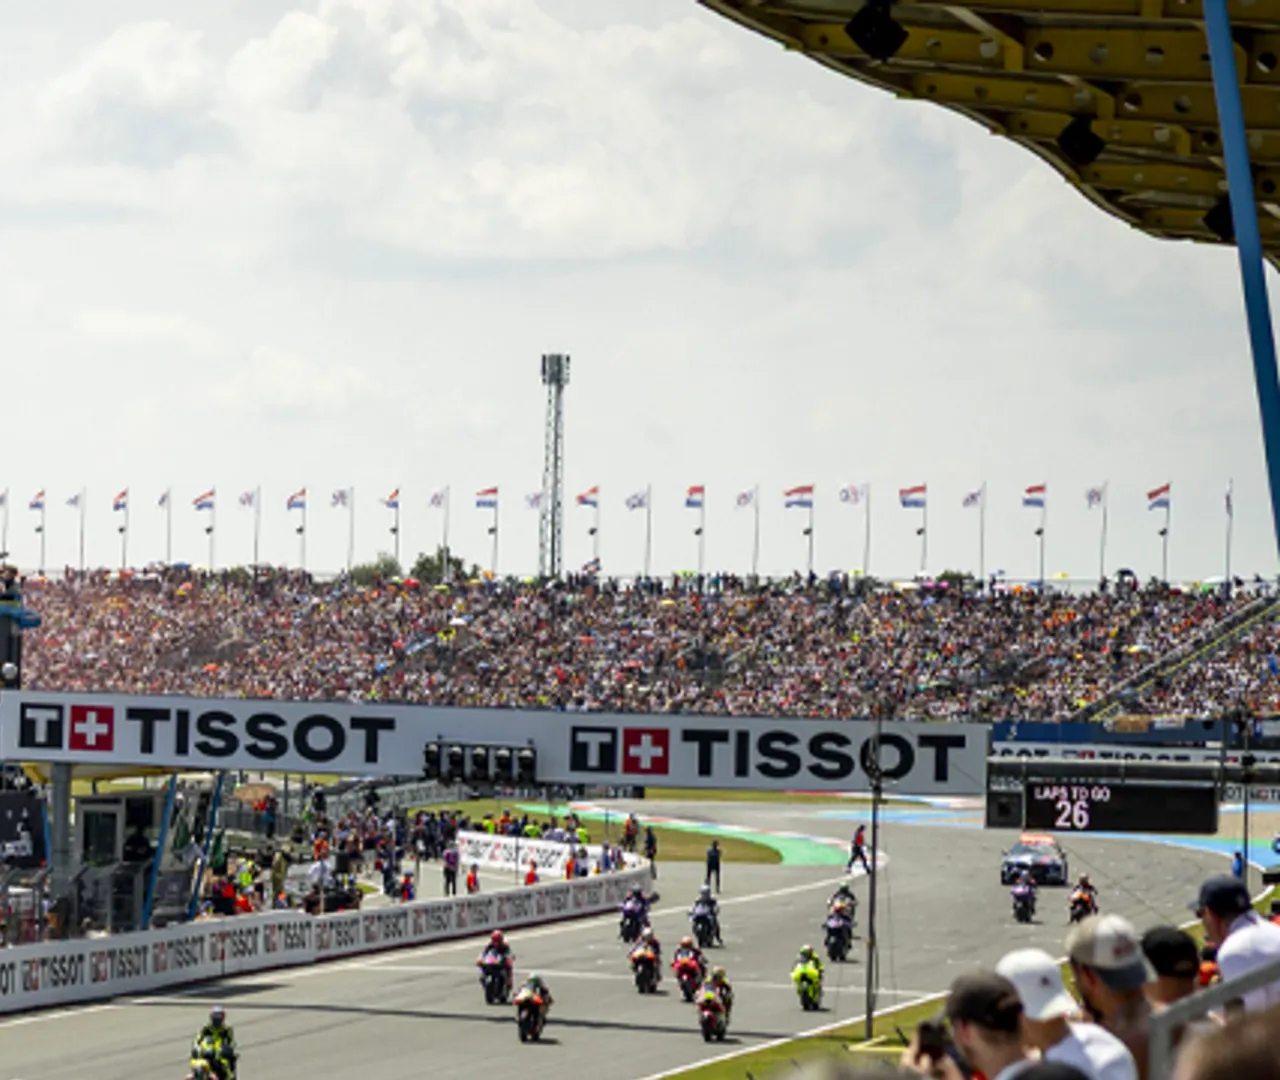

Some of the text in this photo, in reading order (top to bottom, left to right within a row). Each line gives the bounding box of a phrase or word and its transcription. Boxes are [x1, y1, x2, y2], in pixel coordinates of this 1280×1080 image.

[125, 706, 397, 763] TISSOT
[680, 728, 967, 783] TISSOT
[1034, 786, 1110, 802] LAPS TO GO
[1055, 800, 1089, 829] 26
